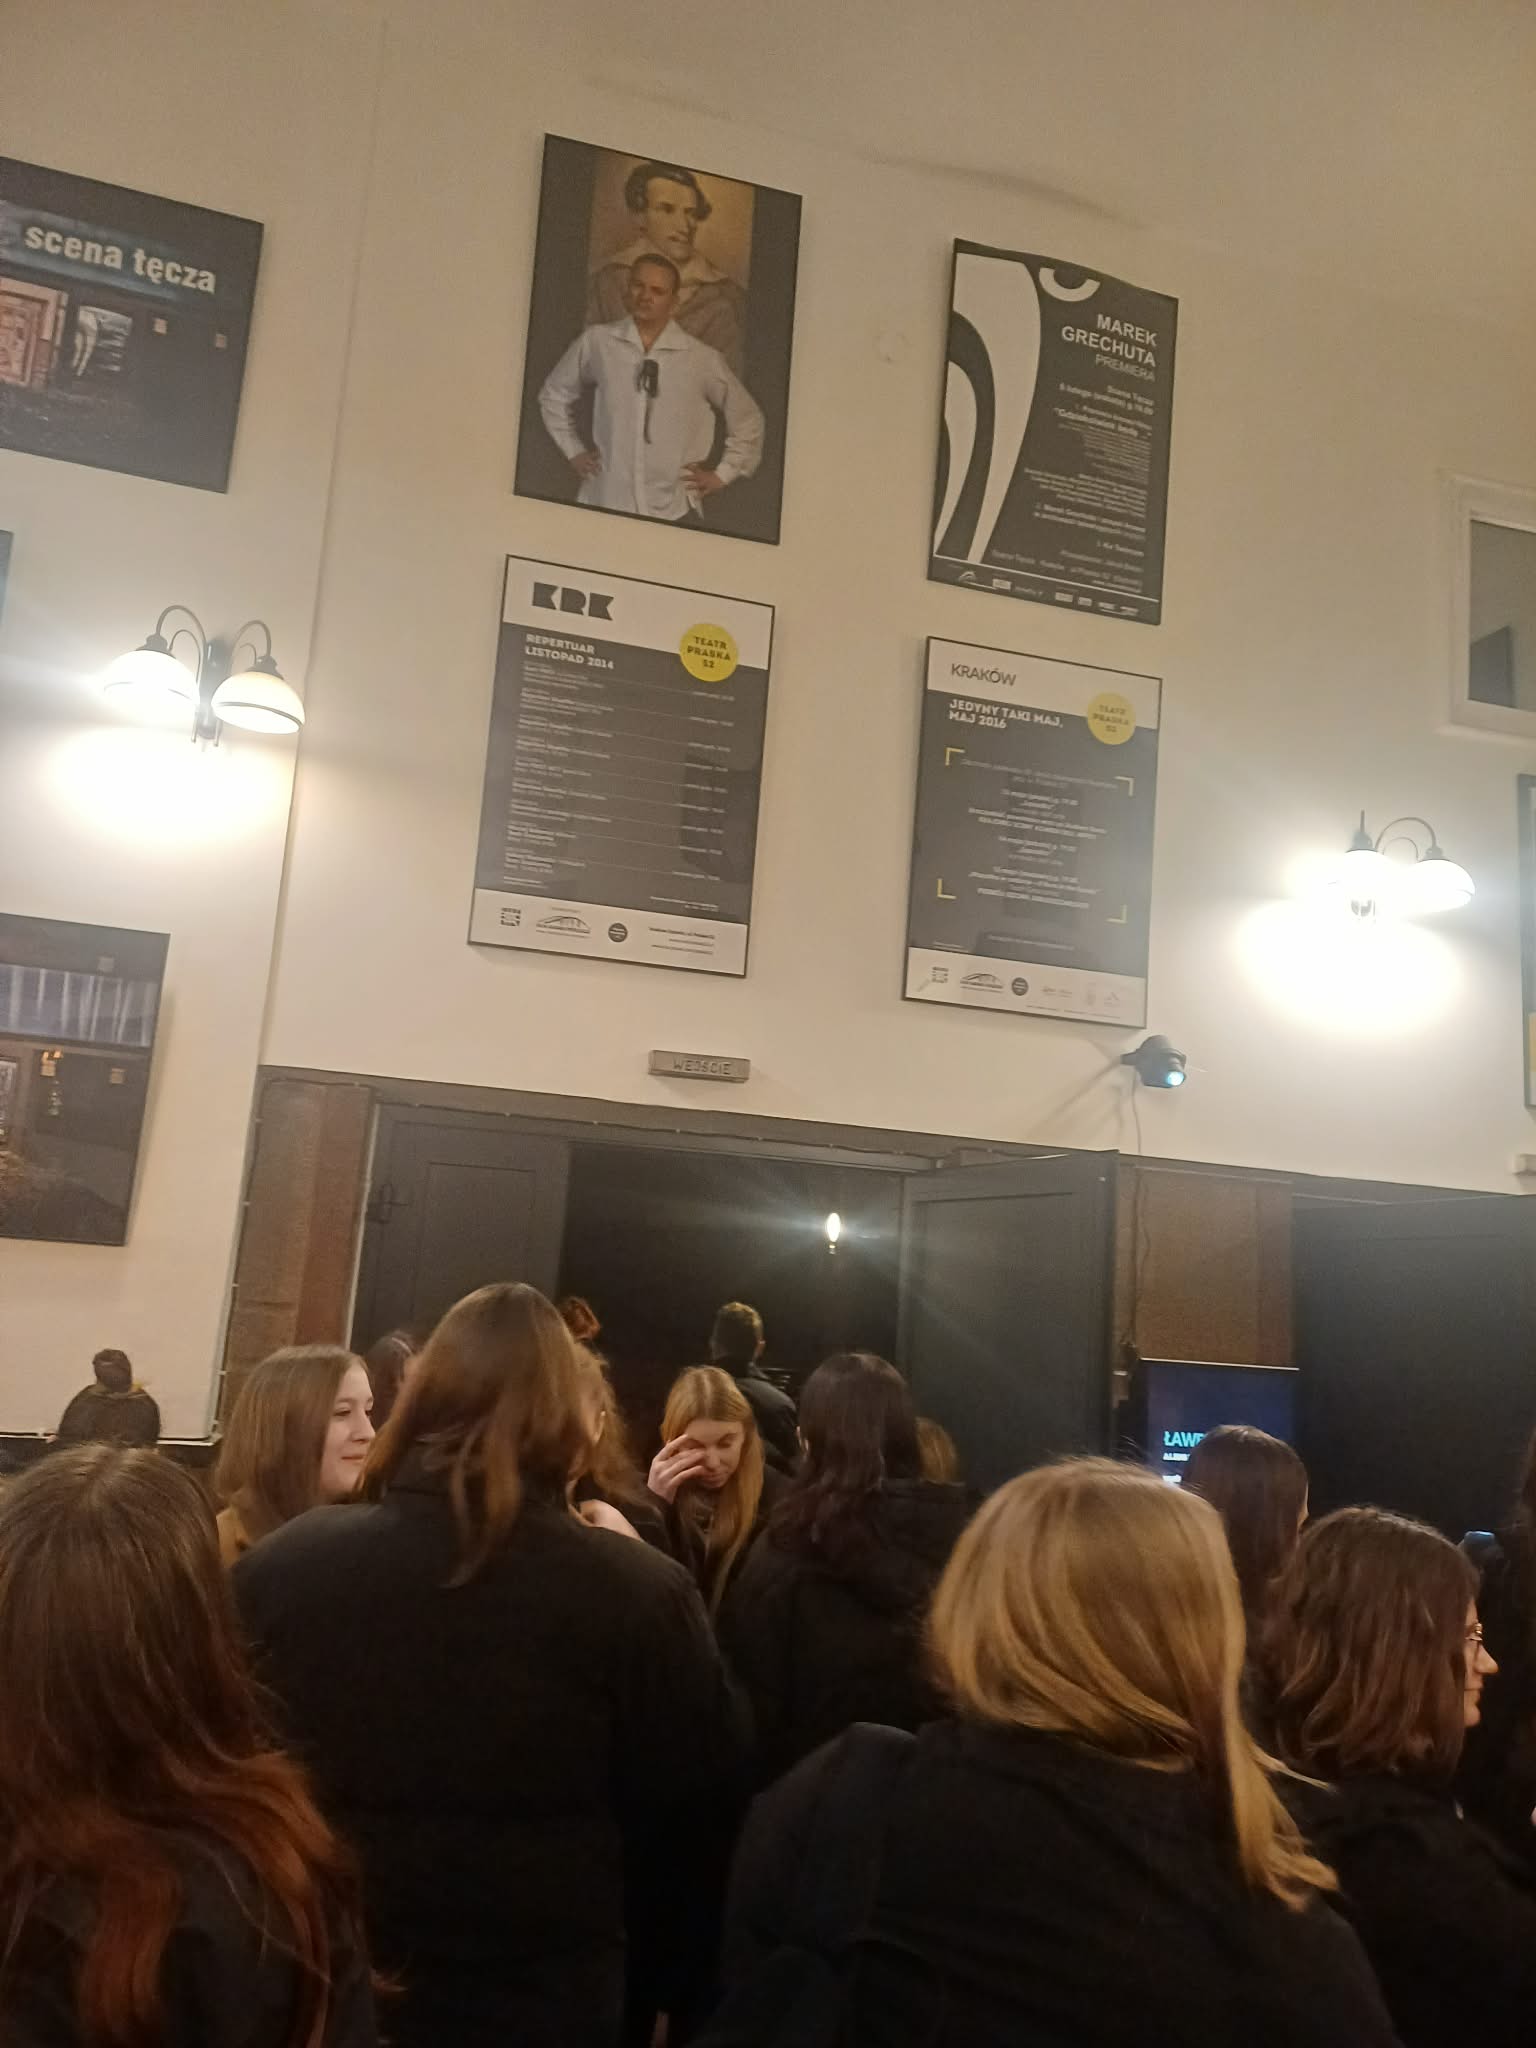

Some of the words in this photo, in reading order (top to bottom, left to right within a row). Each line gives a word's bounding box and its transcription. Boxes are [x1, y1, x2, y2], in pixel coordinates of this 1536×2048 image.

[24, 225, 122, 270] scena
[133, 249, 217, 294] tęcza
[1097, 313, 1158, 348] MAREK
[1061, 325, 1156, 367] GRECHUTA
[1095, 354, 1156, 382] PREMIERA
[531, 581, 615, 621] KRK
[524, 633, 596, 655] REPERTUAR
[687, 645, 732, 661] PRASKA
[694, 636, 728, 649] TEATR
[524, 646, 585, 666] LISTOPAD
[587, 656, 615, 670] 2014
[951, 662, 1017, 687] KRAKÓW
[948, 710, 976, 724] MAJ
[978, 715, 1007, 729] 2016
[949, 699, 1000, 716] JEDYNY
[1001, 707, 1031, 722] TAKI
